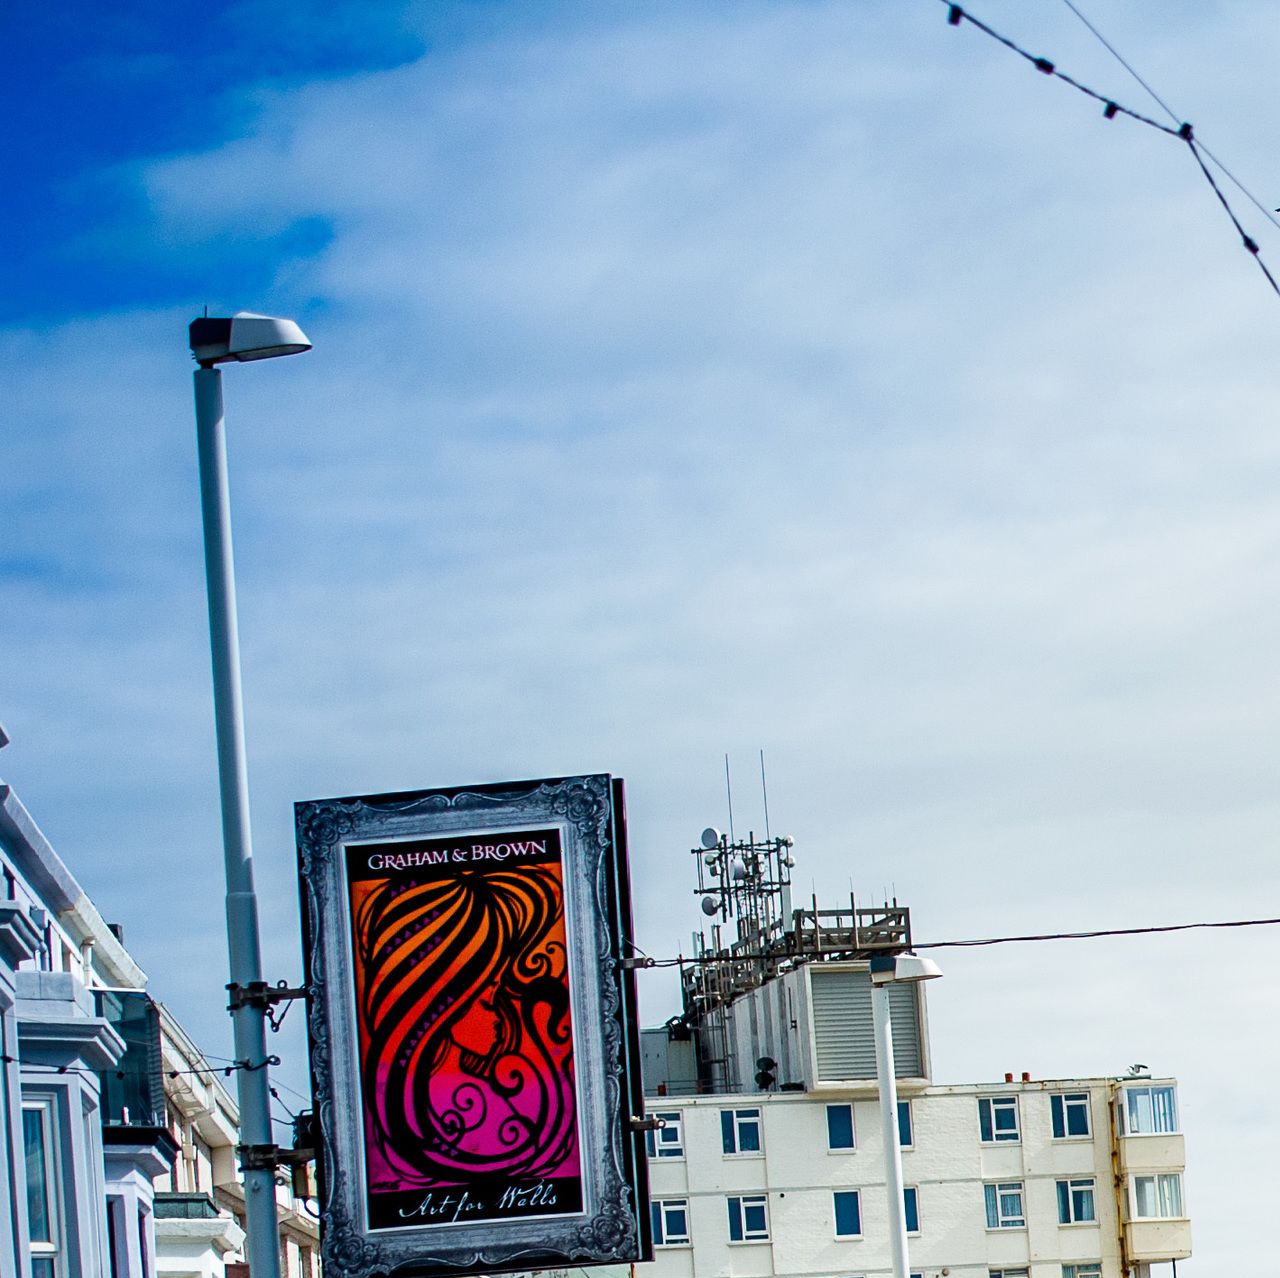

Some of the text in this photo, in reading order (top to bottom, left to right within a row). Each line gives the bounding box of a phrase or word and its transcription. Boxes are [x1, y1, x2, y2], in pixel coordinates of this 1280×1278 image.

[368, 840, 546, 870] GRAHAM & BROWN
[398, 1178, 557, 1223] Art for Walls
